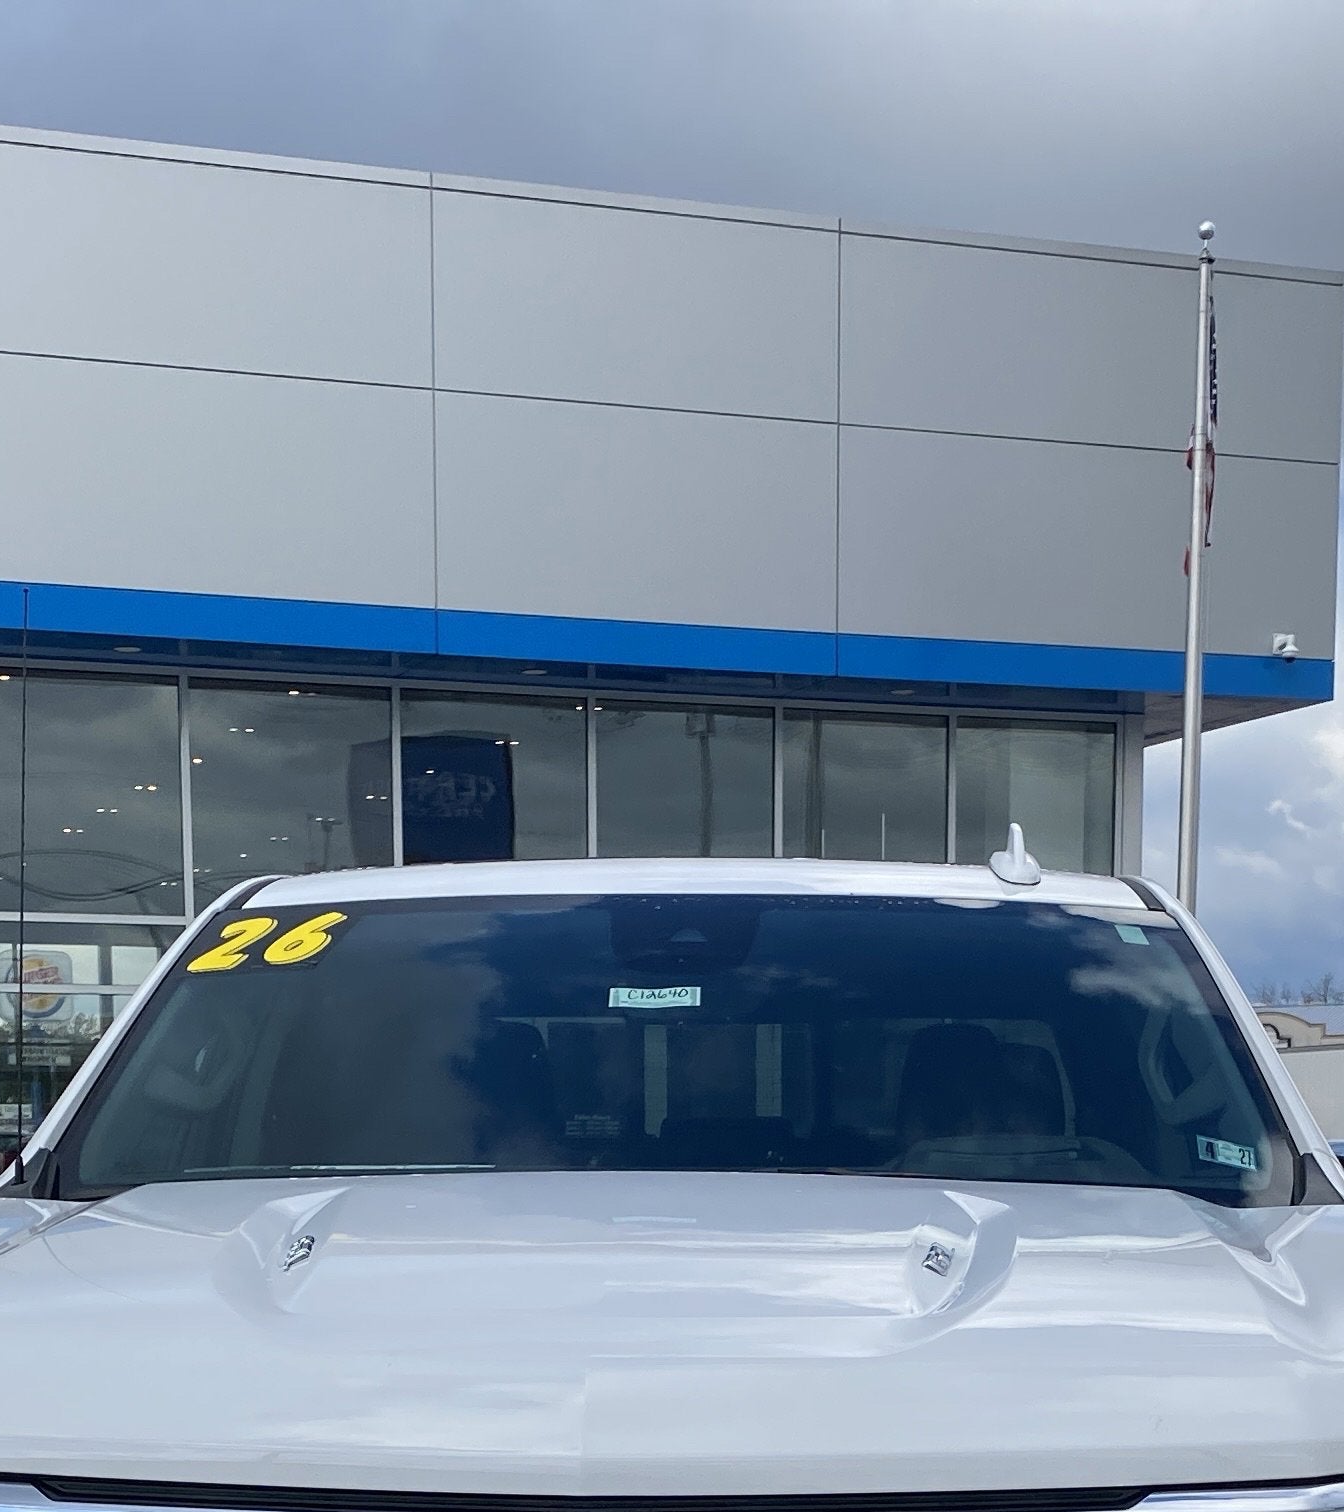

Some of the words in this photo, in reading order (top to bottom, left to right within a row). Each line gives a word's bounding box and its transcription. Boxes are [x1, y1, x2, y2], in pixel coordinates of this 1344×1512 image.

[186, 911, 348, 974] 26
[627, 988, 689, 1000] C12640
[1238, 1148, 1251, 1167] 27
